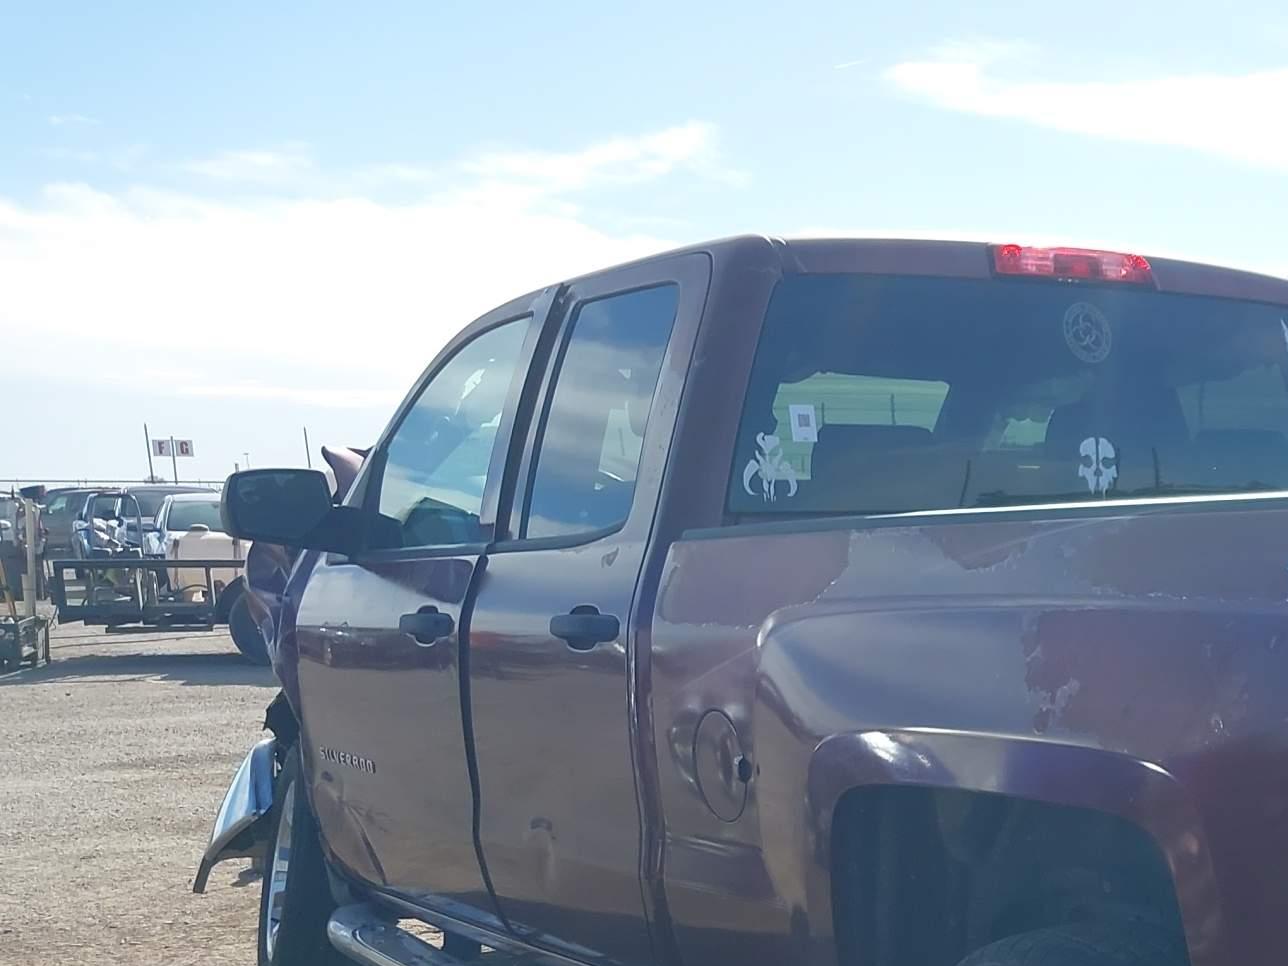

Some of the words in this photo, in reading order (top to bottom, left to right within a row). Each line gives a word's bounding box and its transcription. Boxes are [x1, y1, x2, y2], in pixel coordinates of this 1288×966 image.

[157, 441, 165, 455] F
[179, 441, 190, 455] G
[320, 745, 377, 775] SILVERADO
